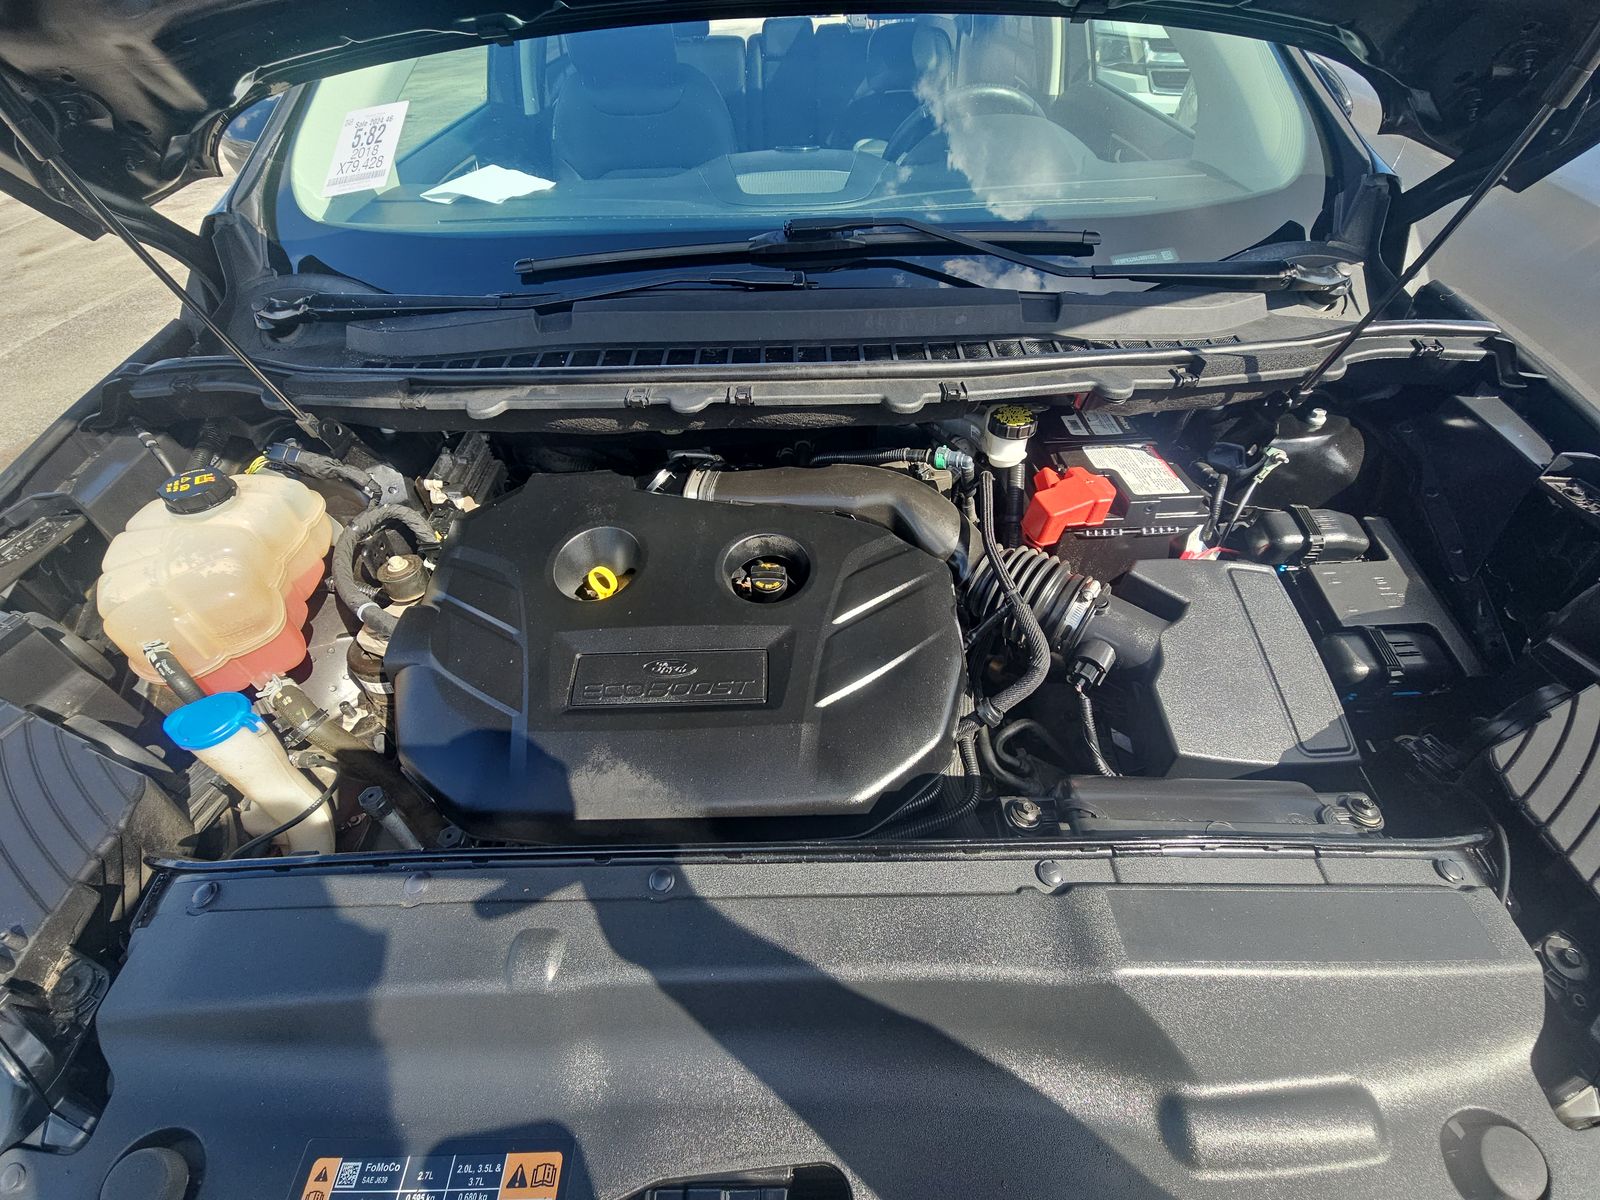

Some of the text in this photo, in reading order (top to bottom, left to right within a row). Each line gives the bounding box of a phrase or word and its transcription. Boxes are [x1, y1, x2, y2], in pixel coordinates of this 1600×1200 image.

[351, 123, 387, 149] 5:82
[350, 144, 380, 160] 2018
[365, 1162, 401, 1172] FoMoCo
[477, 1163, 494, 1173] 3.5L
[495, 1163, 502, 1173] &
[361, 1176, 374, 1184] SAE
[416, 1170, 433, 1181] 2.7L
[468, 1177, 484, 1187] 3.7L
